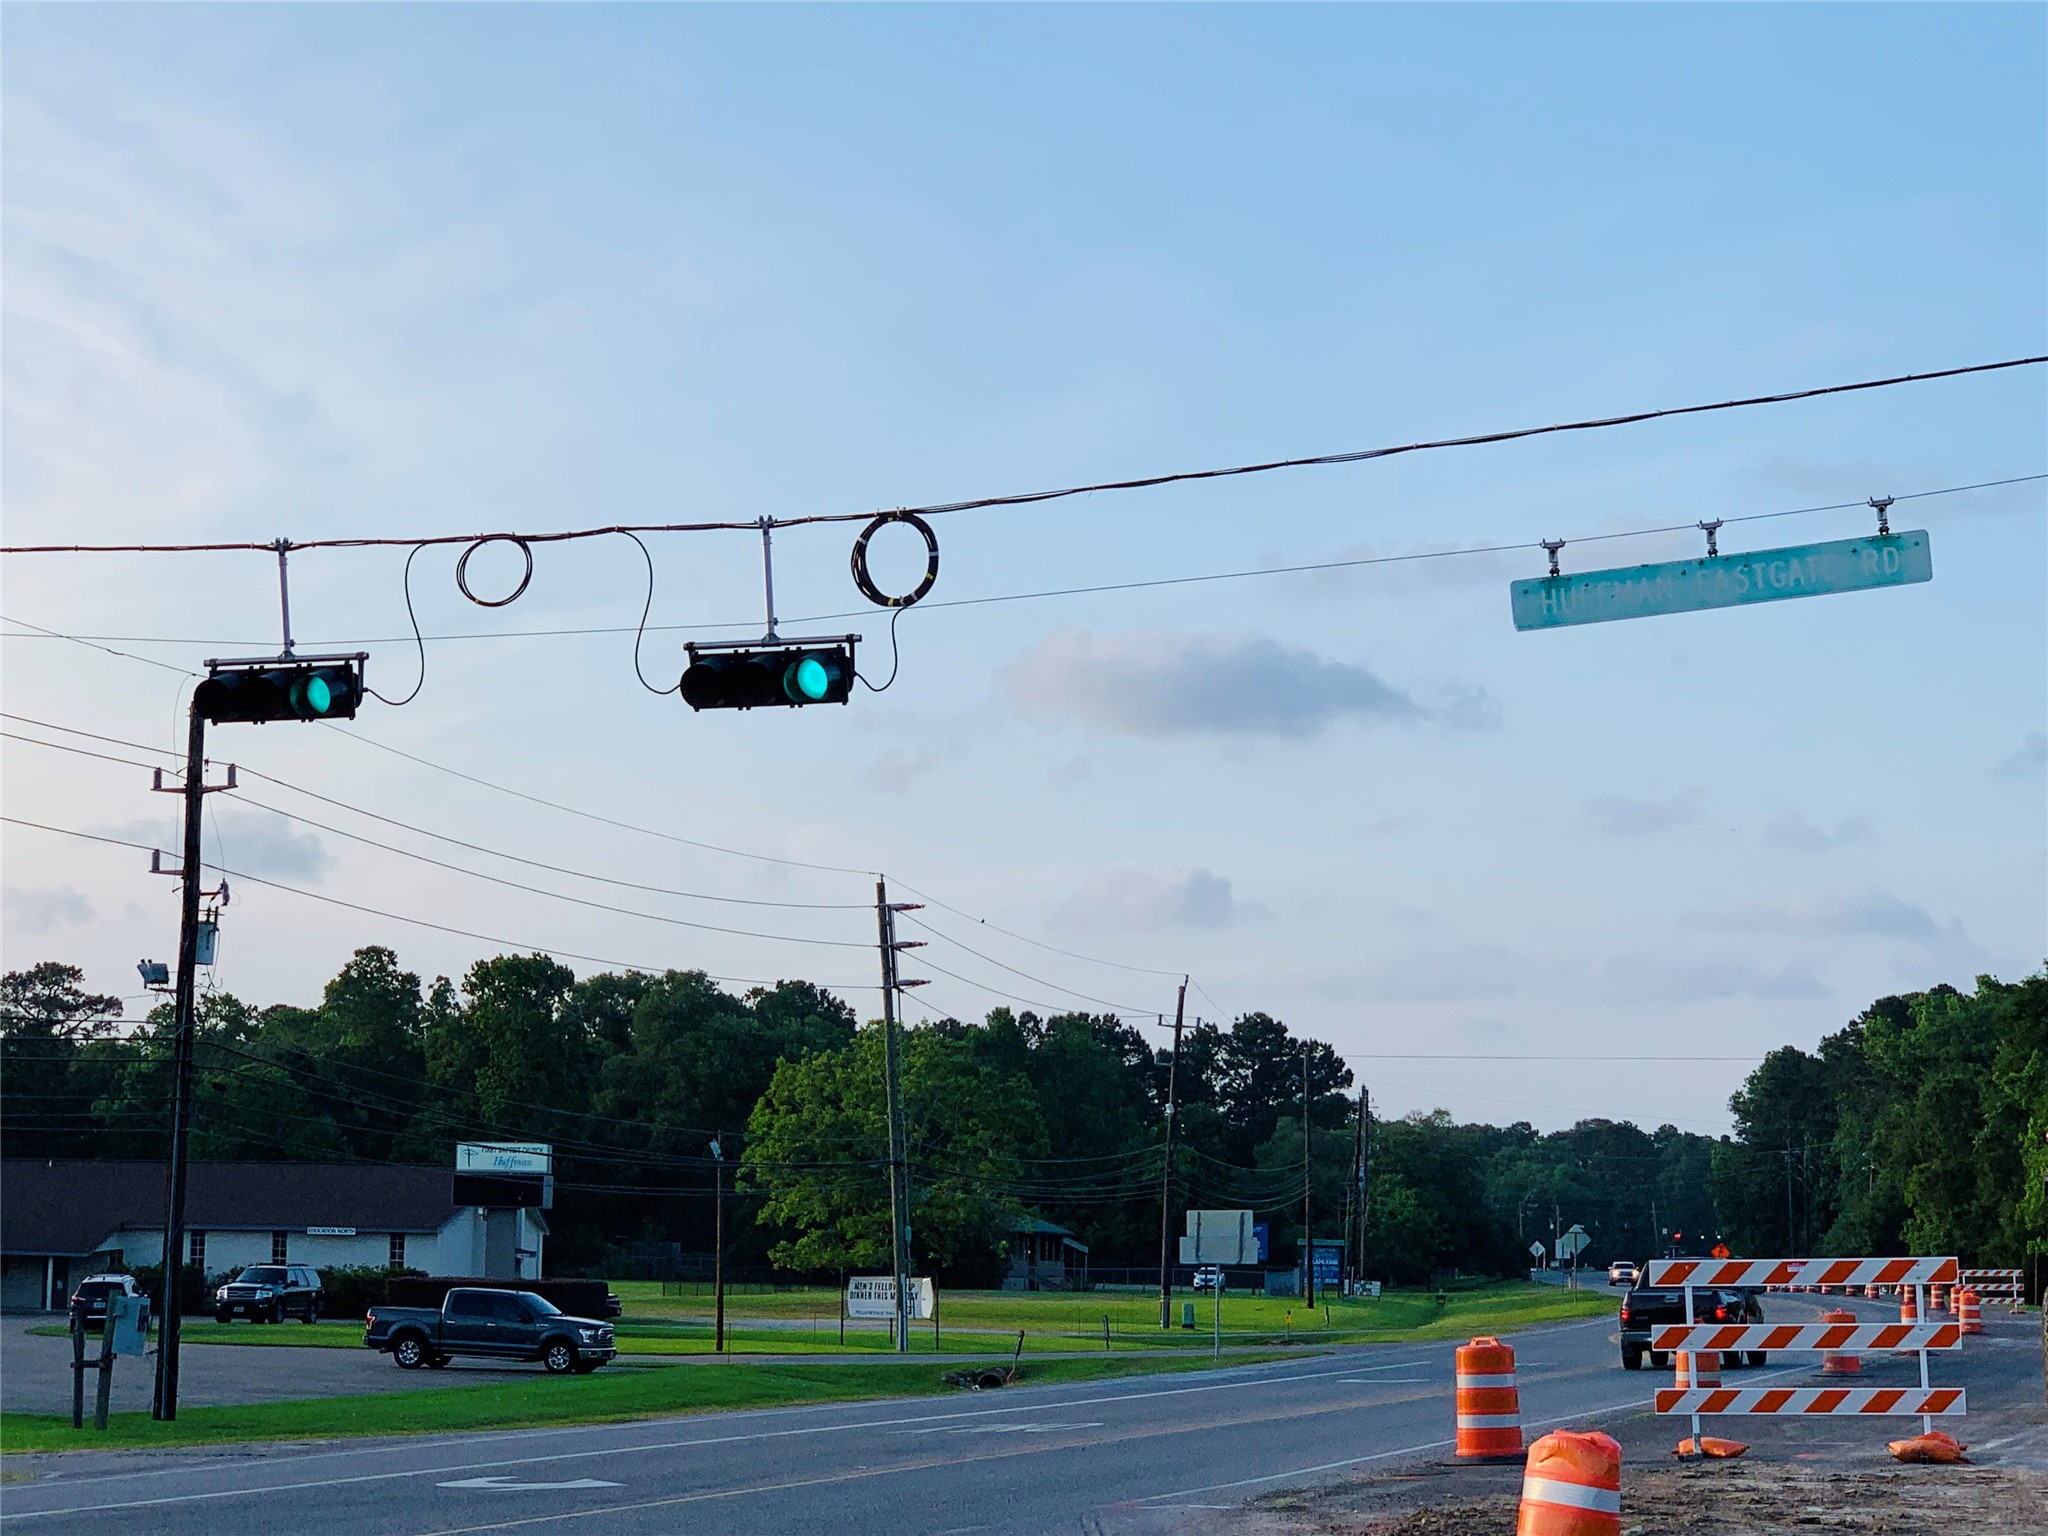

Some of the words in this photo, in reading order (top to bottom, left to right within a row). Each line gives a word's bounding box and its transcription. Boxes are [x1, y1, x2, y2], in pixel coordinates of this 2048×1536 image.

[1859, 547, 1901, 578] RD
[493, 1156, 532, 1169] Huffman
[850, 1291, 872, 1300] DINNER
[874, 1291, 888, 1300] THIS
